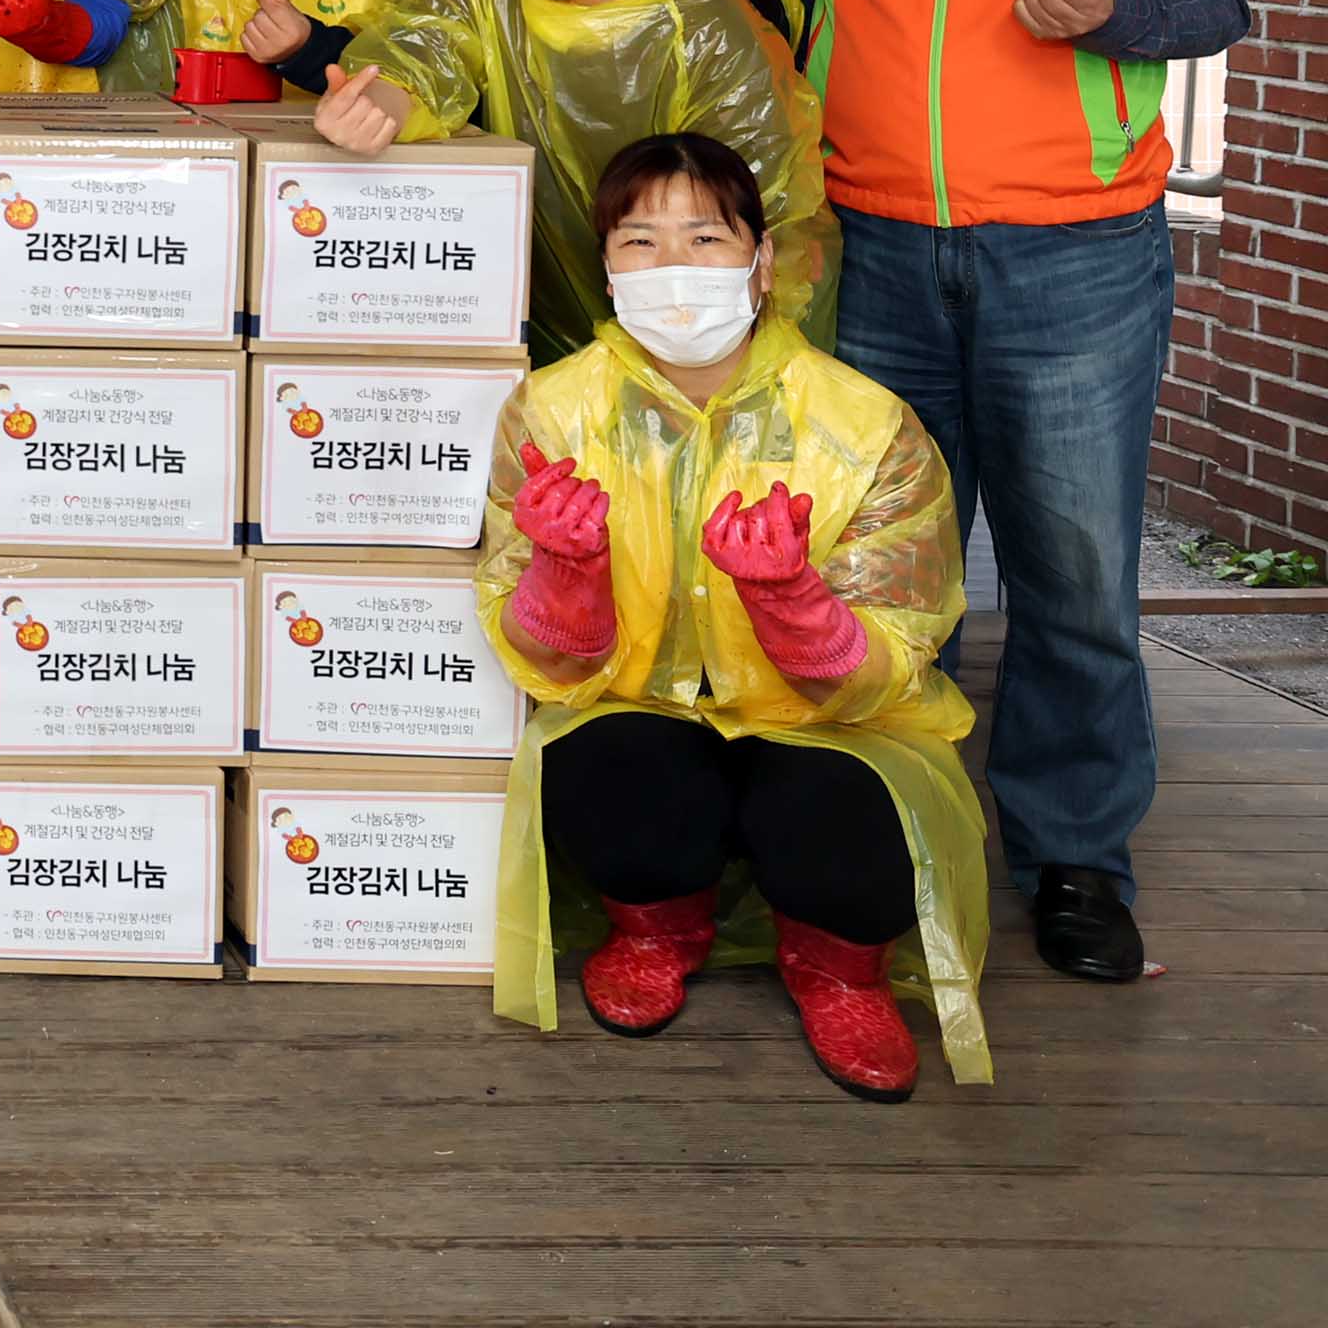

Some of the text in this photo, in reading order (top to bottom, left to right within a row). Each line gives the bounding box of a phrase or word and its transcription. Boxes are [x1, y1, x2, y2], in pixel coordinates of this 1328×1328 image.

[359, 185, 435, 201] <나눔&동행>
[332, 205, 464, 222] 계절김치 및 건강식 전달
[25, 232, 188, 265] 김장김치 나눔
[313, 239, 476, 271] 김장김치 나눔
[316, 292, 339, 305] 주관
[316, 311, 339, 324] 협력
[23, 441, 186, 474] 김장김치 나눔
[310, 440, 472, 472] 김장김치 나눔
[37, 652, 196, 682] 김장김치 나눔
[310, 649, 476, 683] 김장김치 나눔
[7, 858, 168, 890] 김장김치 나눔
[306, 866, 469, 899] 김장김치 나눔
